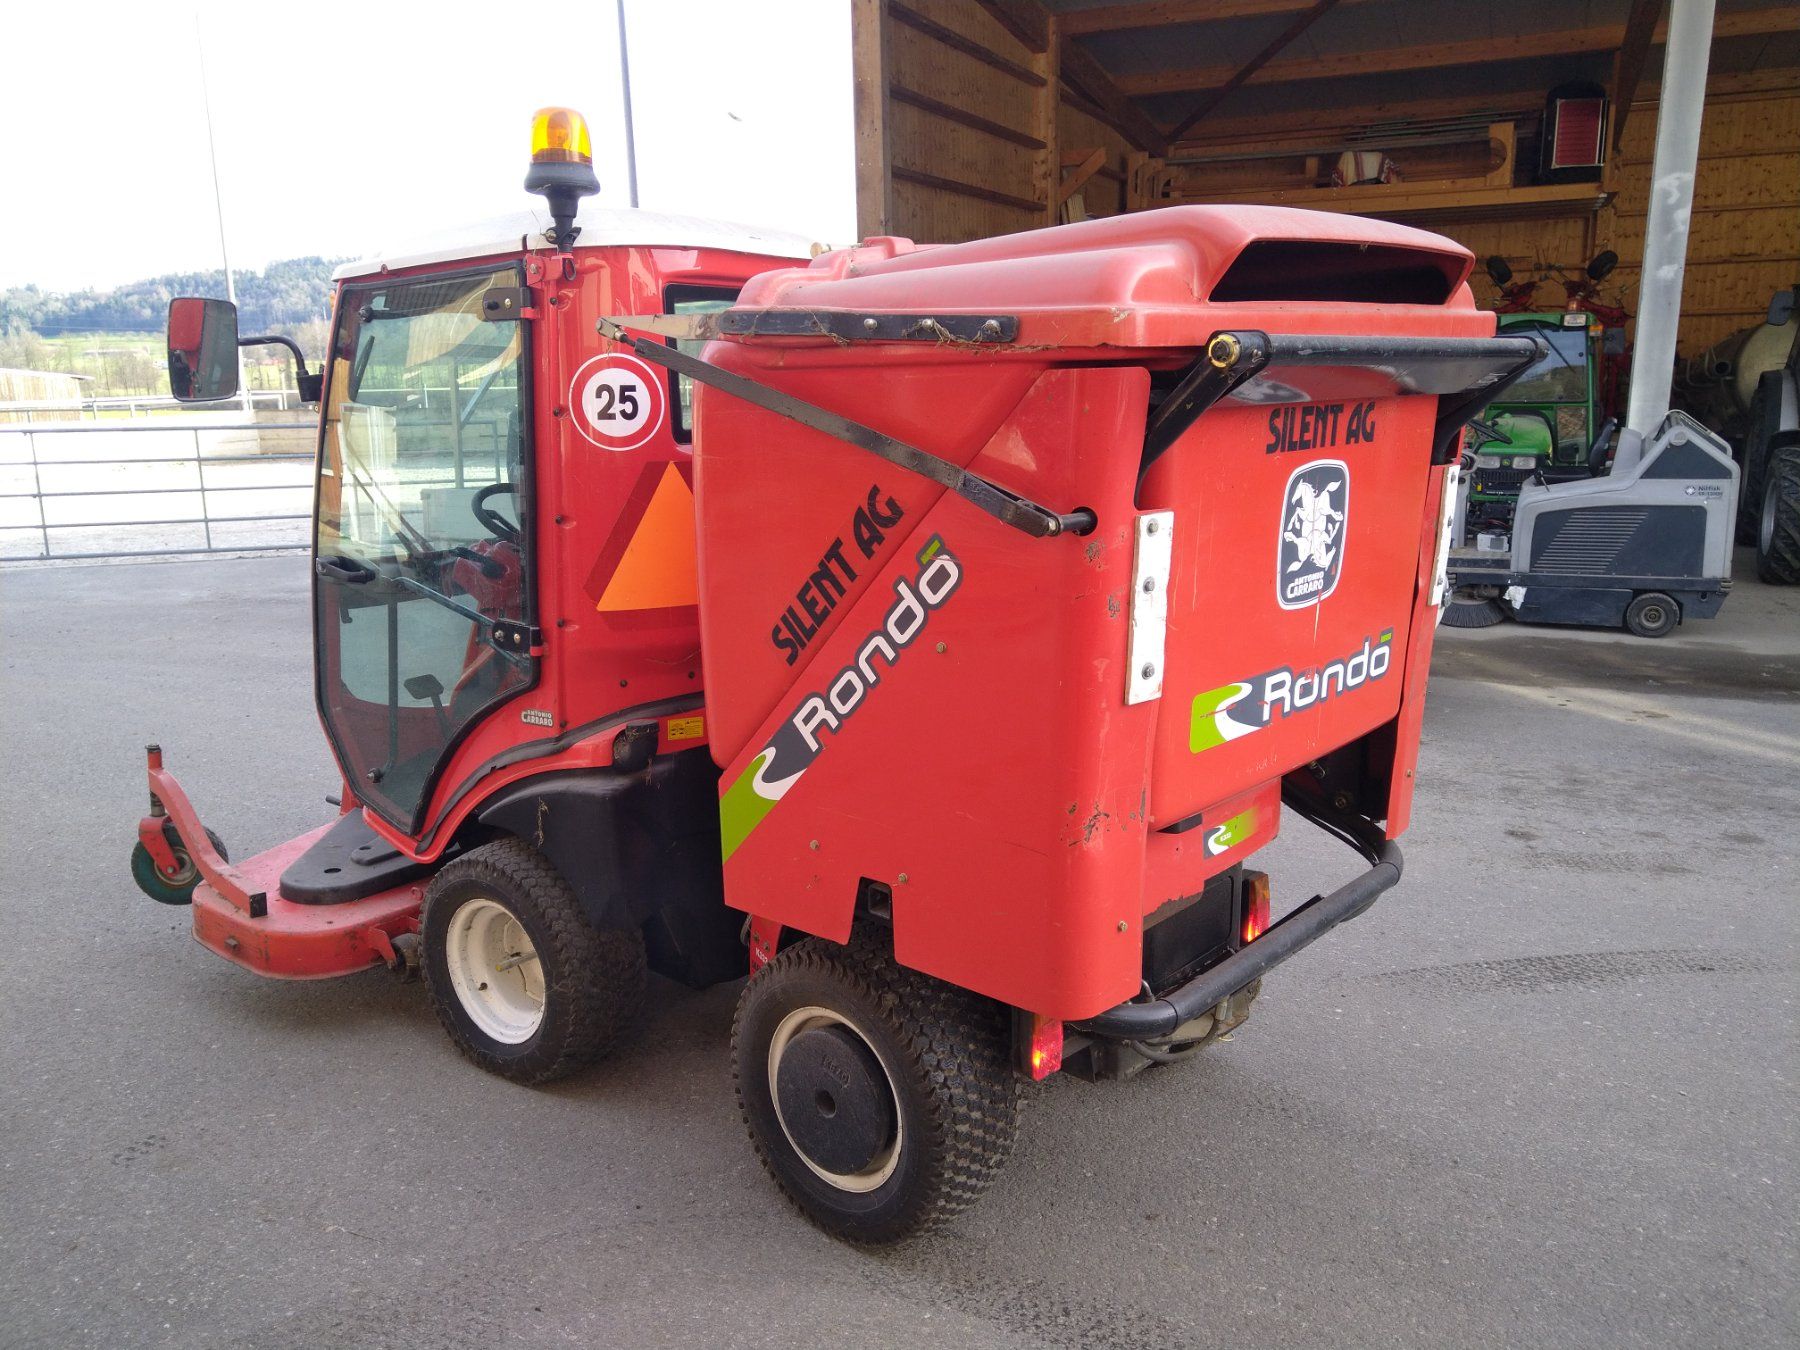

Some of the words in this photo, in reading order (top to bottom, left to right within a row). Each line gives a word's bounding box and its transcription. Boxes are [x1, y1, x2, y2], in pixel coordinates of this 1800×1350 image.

[594, 383, 639, 421] 25
[1265, 403, 1345, 455] SILENT
[1345, 401, 1376, 445] AG
[771, 536, 859, 667] SILENT
[853, 484, 905, 561] AG
[1294, 571, 1325, 586] ANTONIO
[1286, 579, 1324, 599] CARRARO
[521, 711, 553, 727] CARRARO
[526, 709, 552, 719] ANTONIO
